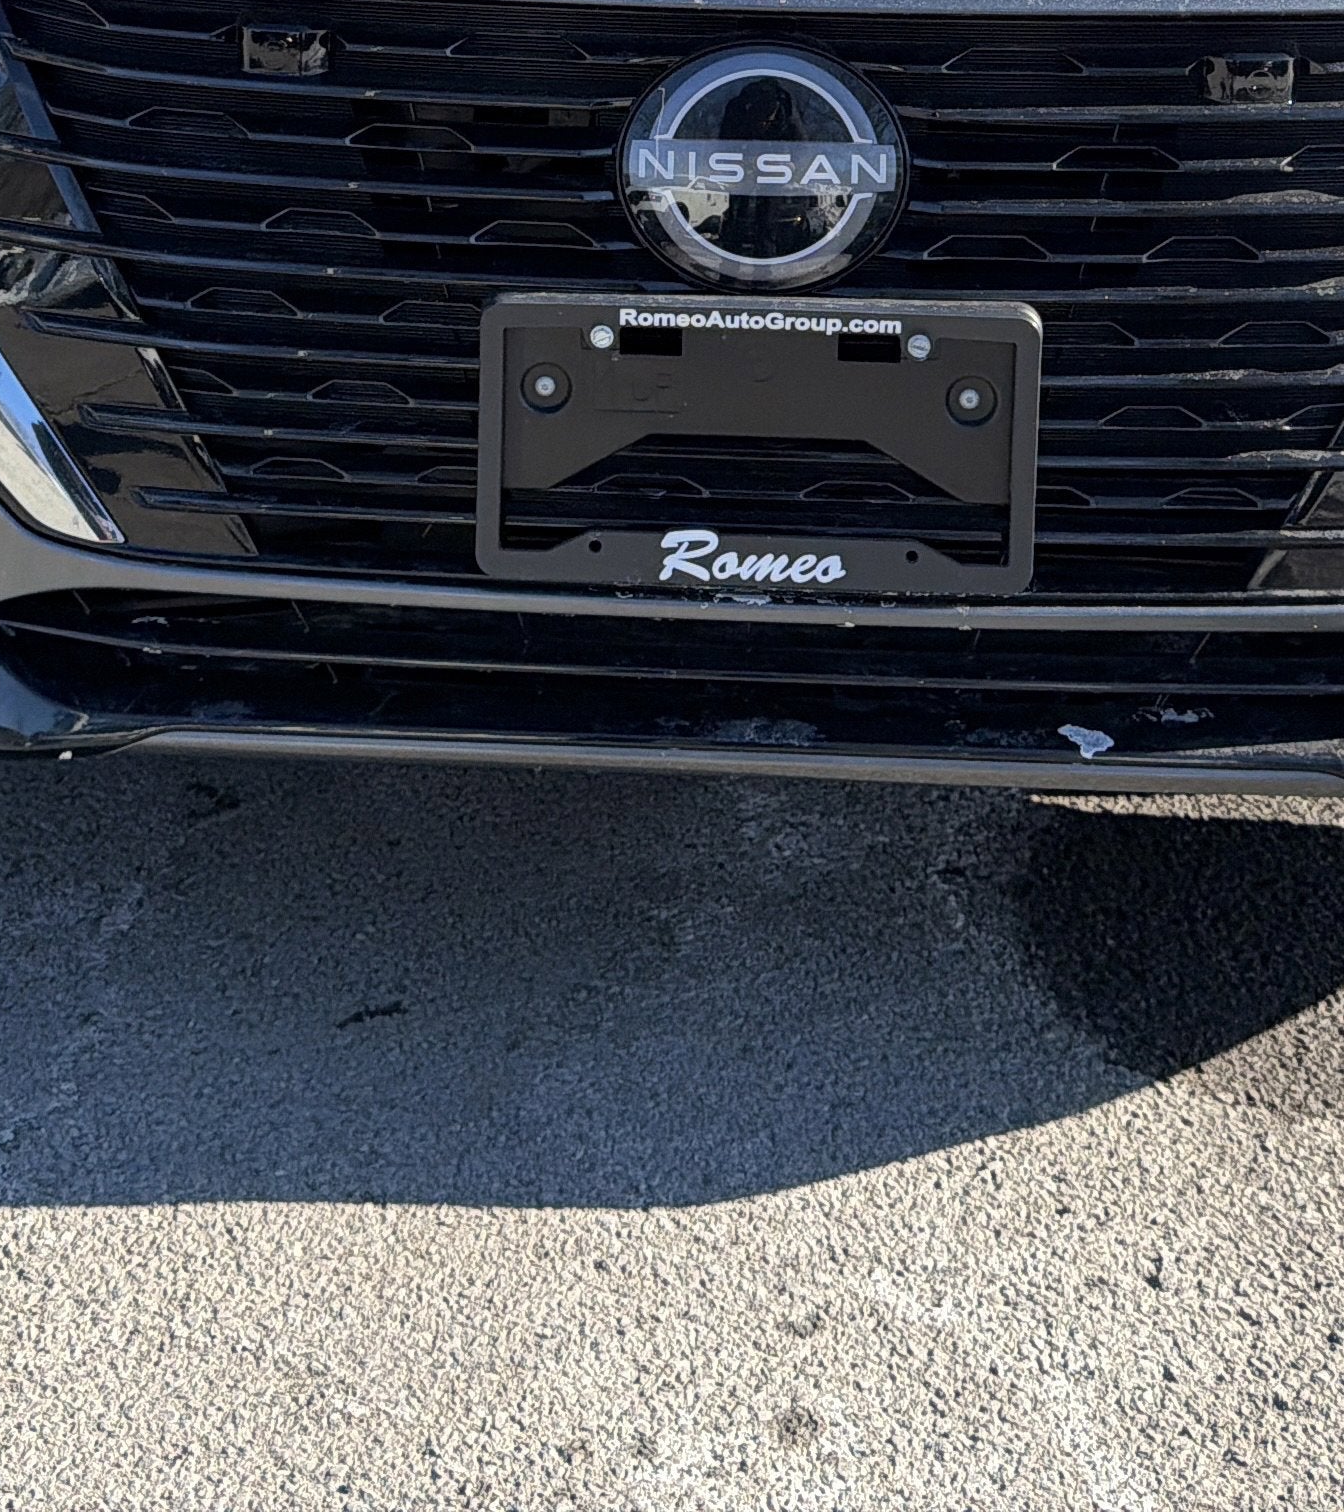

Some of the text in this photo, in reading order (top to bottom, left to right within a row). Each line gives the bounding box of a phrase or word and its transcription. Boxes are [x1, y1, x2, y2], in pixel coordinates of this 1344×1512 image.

[637, 147, 888, 185] NISSAN
[618, 307, 903, 335] RomeoAutoGroup.com
[658, 528, 847, 584] Romeo
